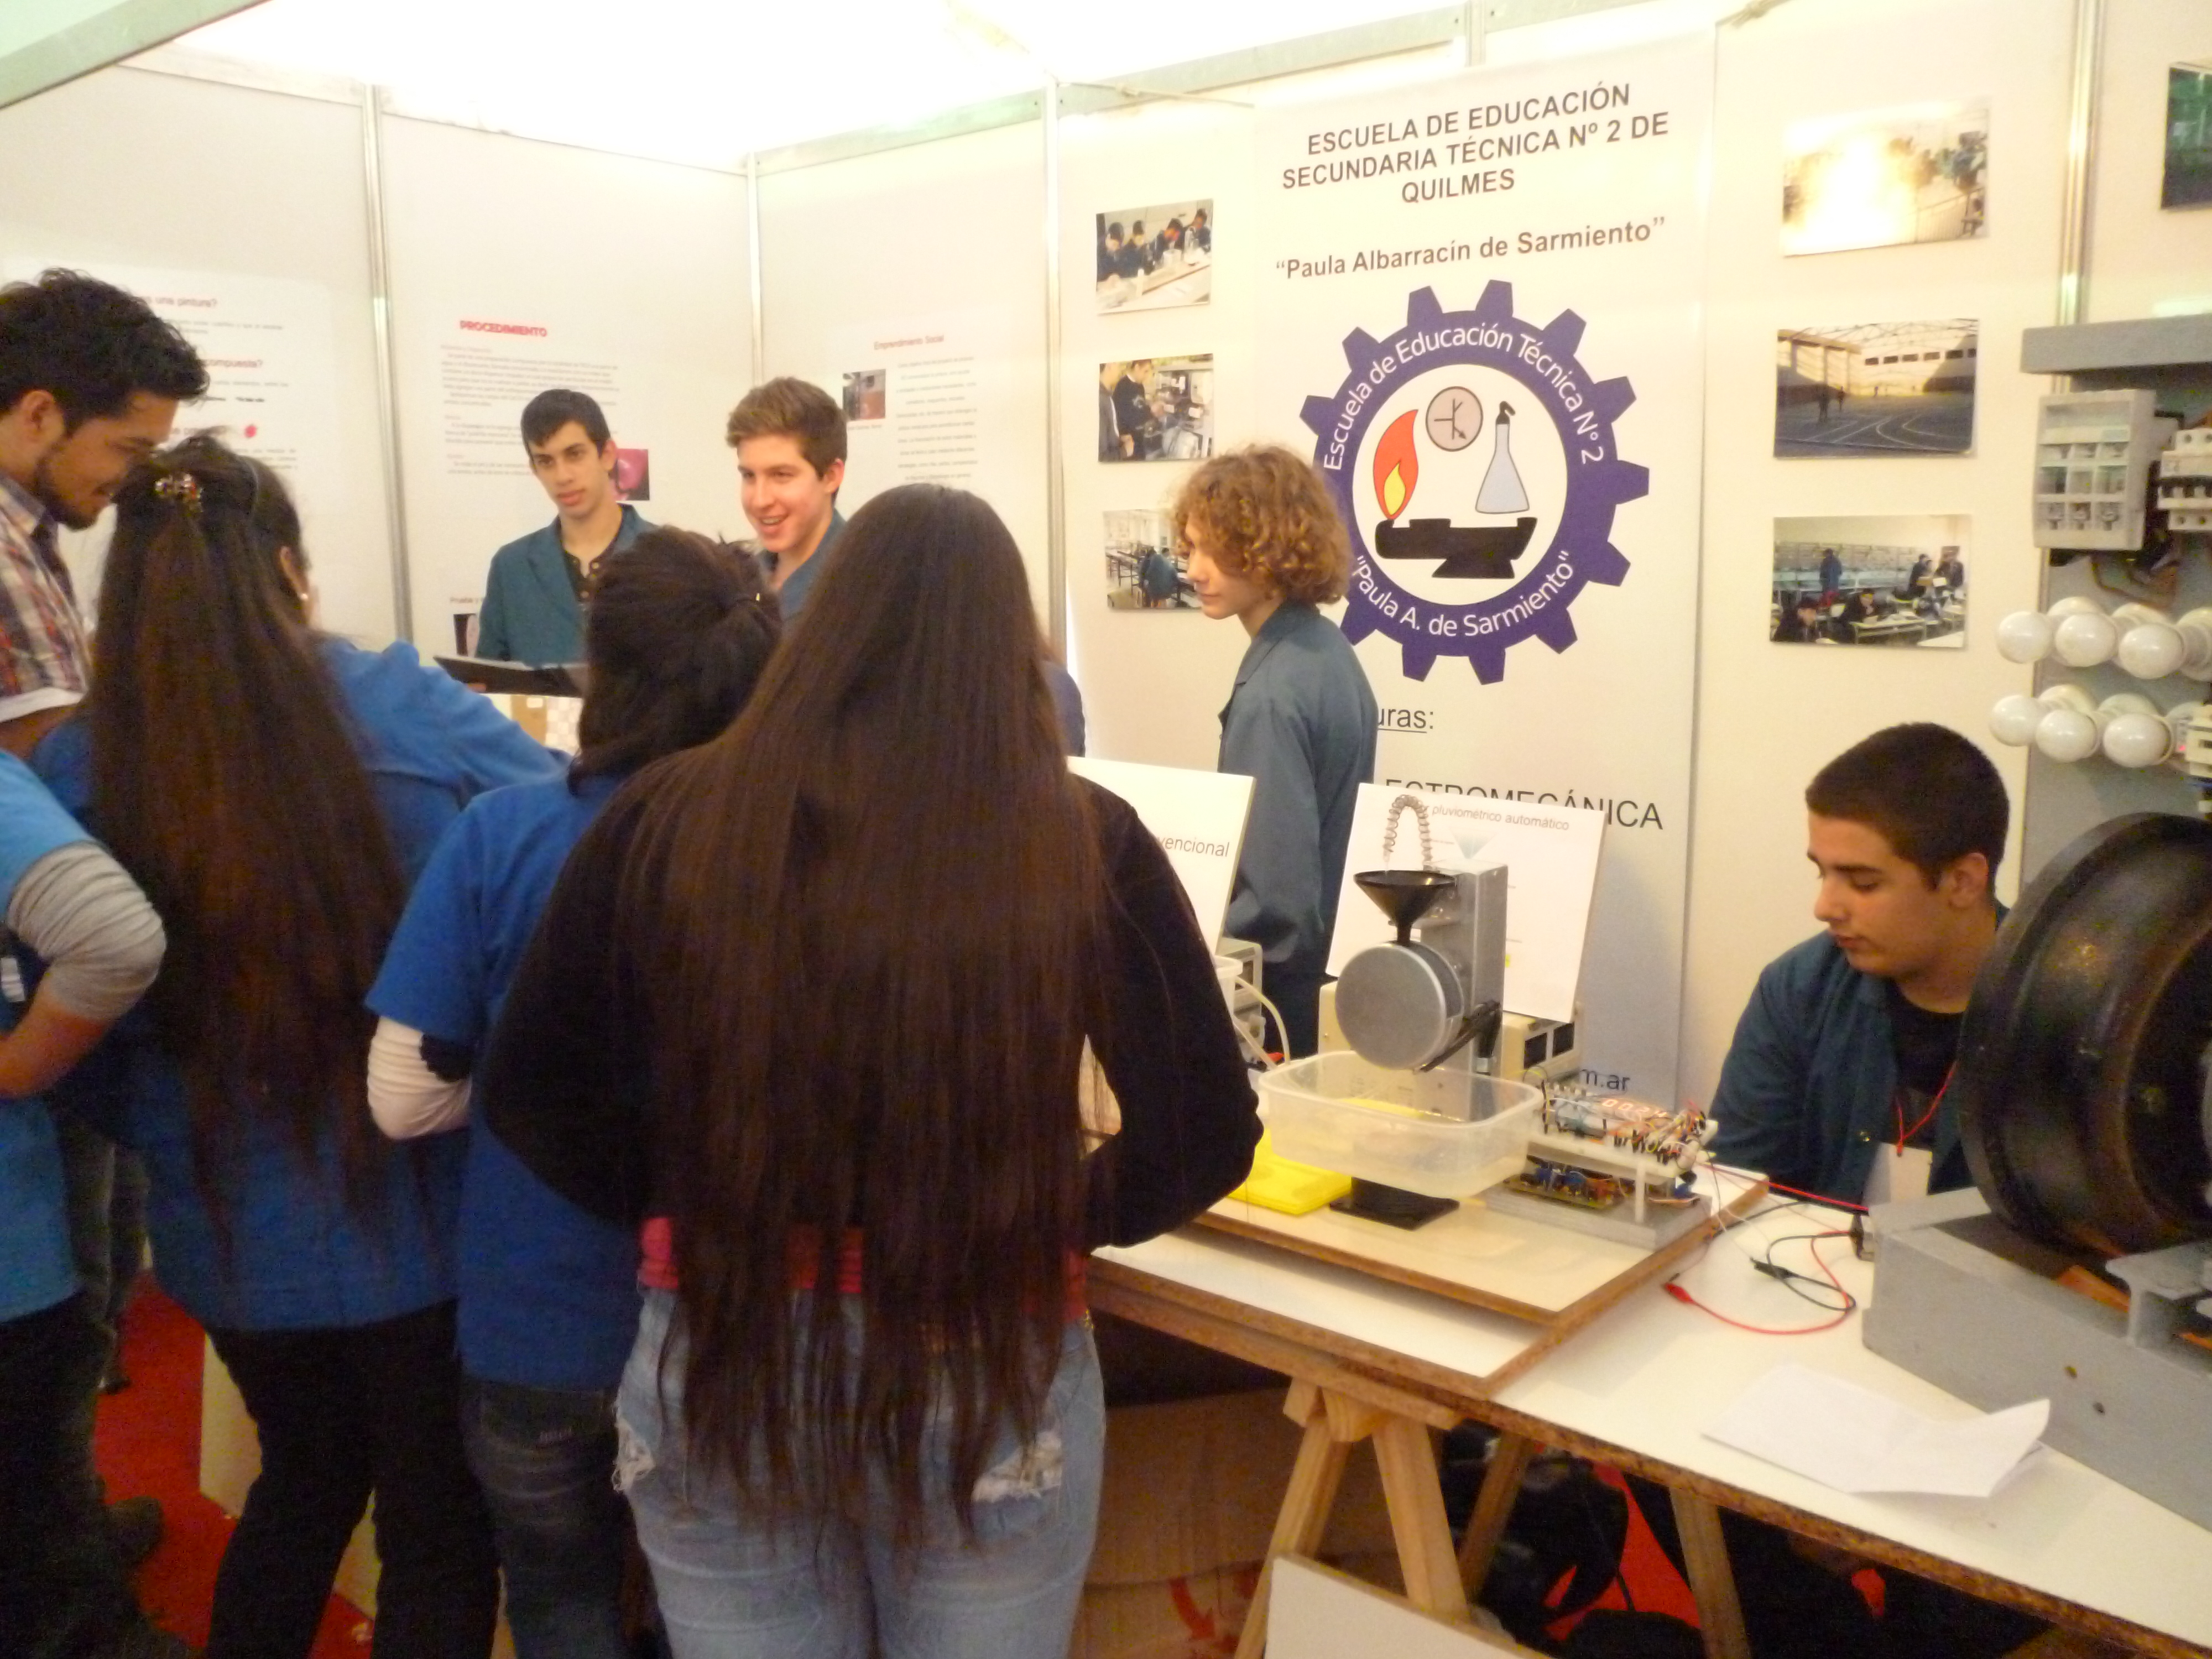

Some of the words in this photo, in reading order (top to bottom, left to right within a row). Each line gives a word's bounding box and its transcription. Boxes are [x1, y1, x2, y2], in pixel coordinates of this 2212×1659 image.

[1307, 118, 1418, 155] ESCUELA
[1426, 111, 1459, 138] DE
[1468, 81, 1630, 131] EDUCACIÓN
[1282, 147, 1437, 189] SECUNDARIA
[1447, 129, 1560, 165] TÉCNICA
[1606, 120, 1621, 143] 2
[1631, 112, 1669, 139] DE
[1401, 168, 1515, 203] QUILMES
[1353, 240, 1470, 272] Albarracín
[1479, 234, 1508, 258] de
[460, 320, 547, 337] PROCEDIMIENTO
[1324, 382, 1373, 470] Escuela
[1369, 356, 1397, 384] de
[1395, 322, 1514, 364] Educación
[1518, 333, 1585, 413] Técnica
[1581, 445, 1604, 464] 2
[1400, 607, 1421, 630] A.
[1428, 615, 1458, 637] de
[1432, 805, 1502, 823] pluviométrico
[1505, 815, 1569, 831] automático
